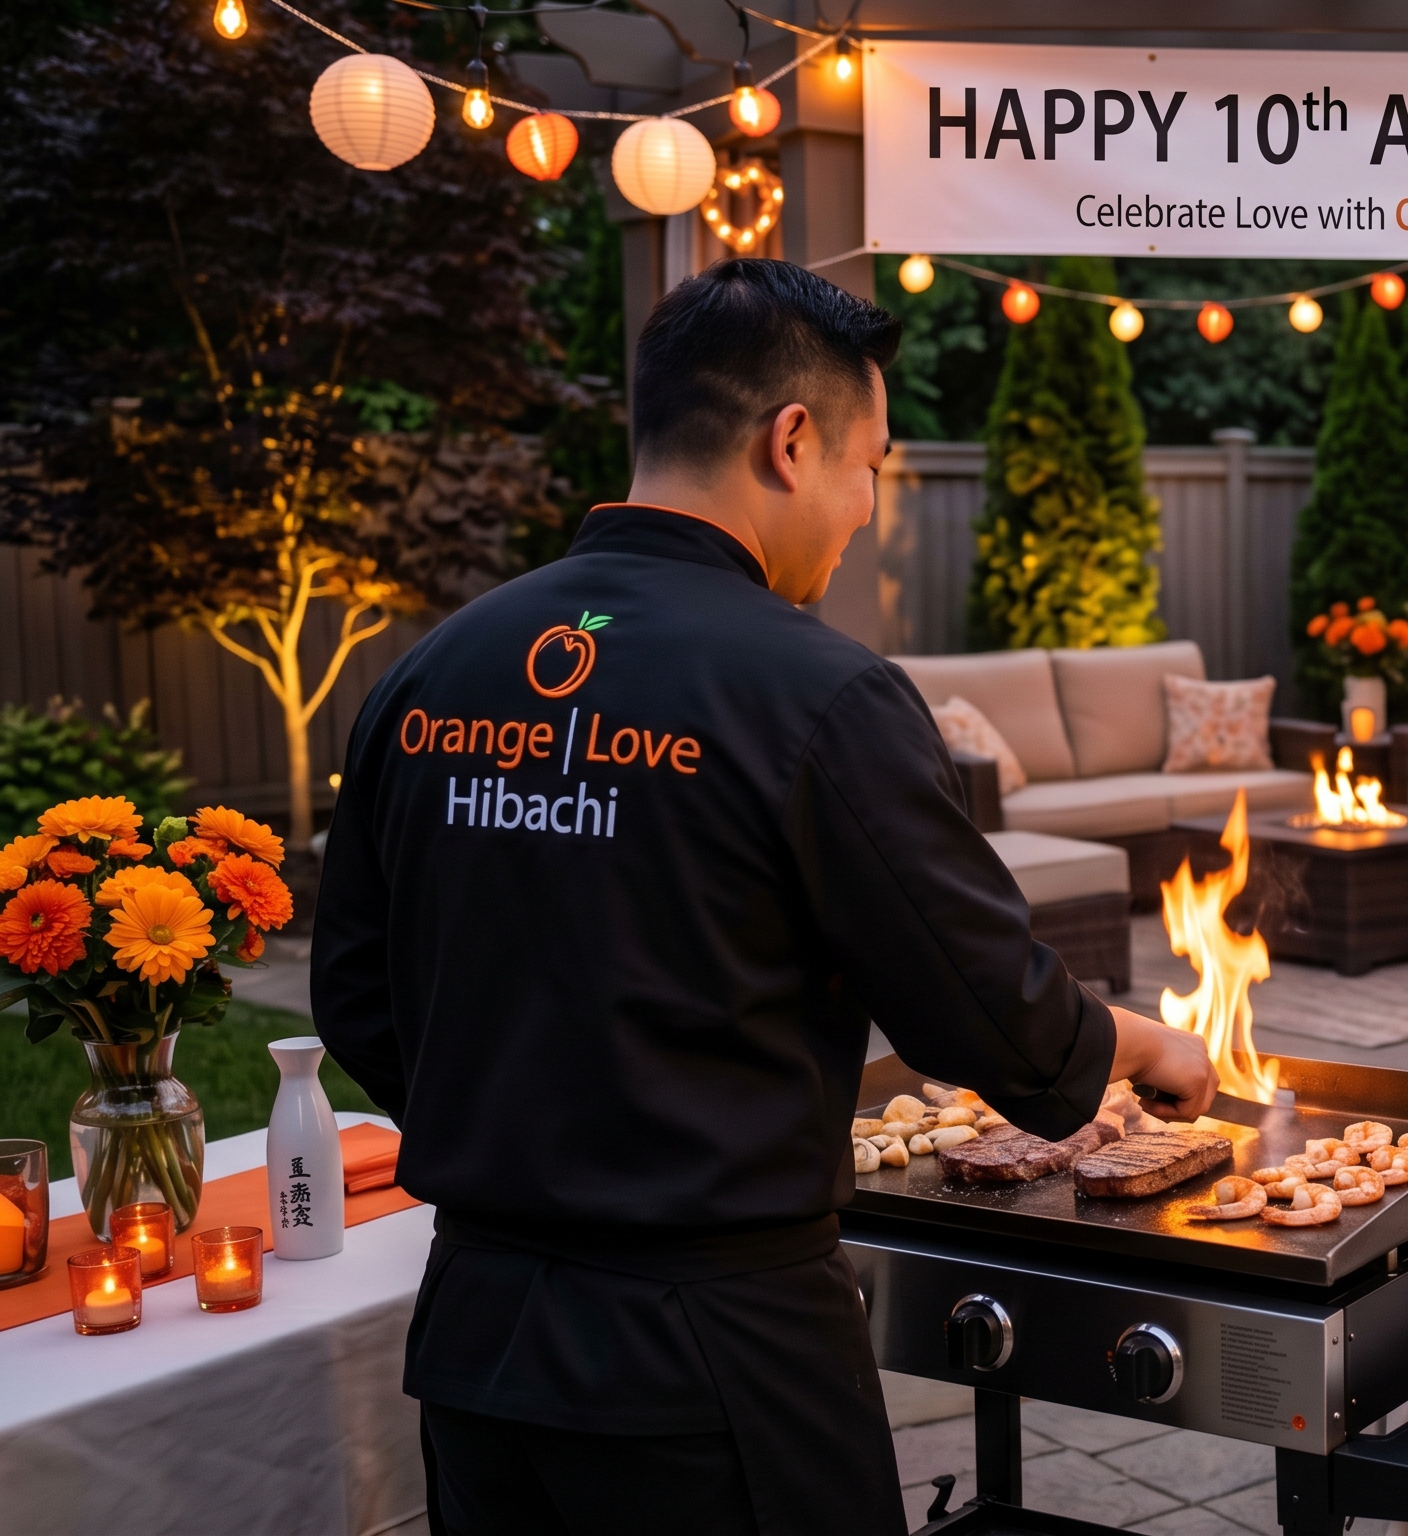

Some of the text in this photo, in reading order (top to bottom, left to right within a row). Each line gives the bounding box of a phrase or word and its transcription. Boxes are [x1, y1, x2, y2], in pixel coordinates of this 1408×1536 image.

[928, 86, 1187, 163] HAPPY
[1214, 85, 1349, 165] 10th
[1075, 193, 1226, 230] Celebrate
[1235, 195, 1308, 230] Love
[1317, 195, 1386, 231] with
[400, 708, 554, 770] Orange
[586, 713, 701, 774] Love
[447, 776, 618, 838] Hibachi
